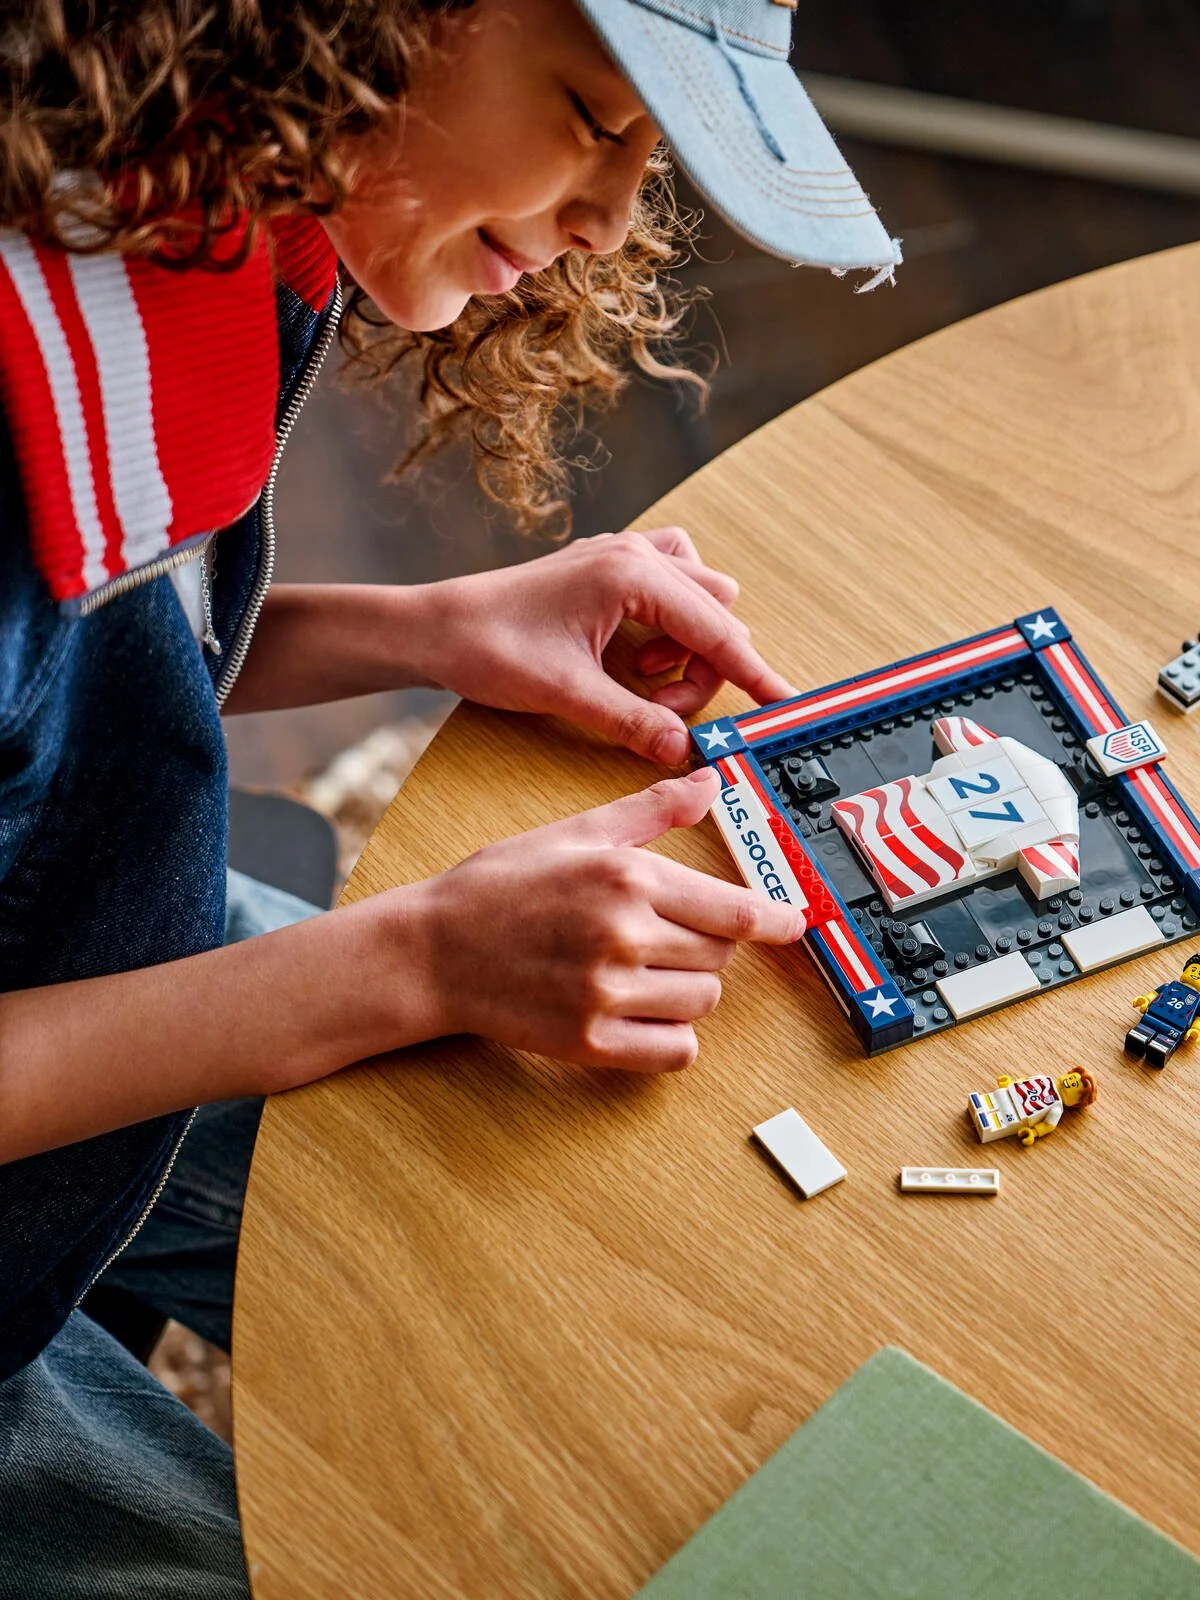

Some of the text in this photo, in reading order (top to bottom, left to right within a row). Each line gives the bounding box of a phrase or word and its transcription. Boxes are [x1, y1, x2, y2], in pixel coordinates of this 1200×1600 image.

[1130, 730, 1152, 752] USA
[947, 772, 1025, 823] 27
[721, 787, 792, 905] U.S. SOCCE
[1167, 998, 1185, 1010] 26
[1168, 1030, 1179, 1038] 26
[1026, 1088, 1041, 1101] 26
